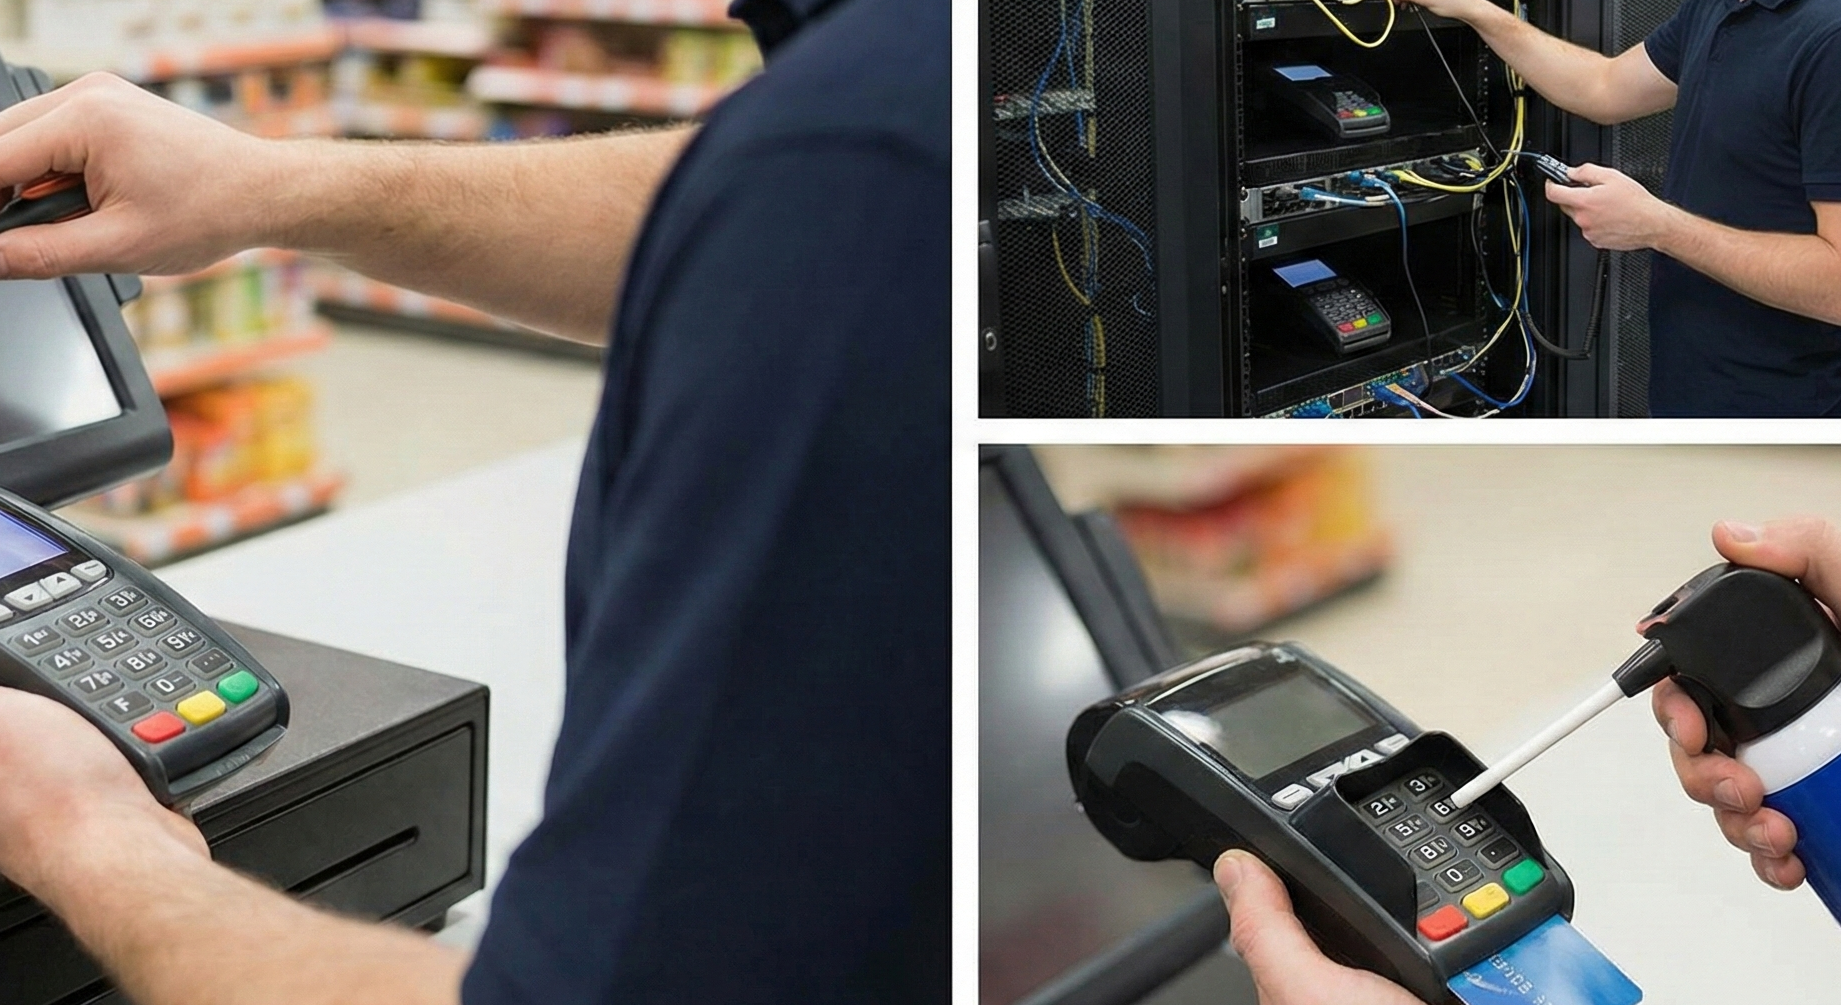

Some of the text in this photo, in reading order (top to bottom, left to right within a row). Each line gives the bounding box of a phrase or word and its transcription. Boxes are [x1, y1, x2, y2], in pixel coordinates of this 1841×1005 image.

[23, 634, 40, 645] 1
[69, 615, 88, 627] 2
[110, 595, 128, 606] 3
[55, 655, 71, 668] 4
[97, 635, 116, 648] 5
[138, 615, 156, 628] 6
[80, 676, 97, 689] 7
[127, 657, 146, 669] 8
[167, 637, 185, 649] 9
[113, 679, 175, 712] F 0
[1370, 802, 1388, 815] 2
[1409, 779, 1426, 792] 3
[1395, 824, 1412, 837] 5
[1434, 801, 1450, 815] 6
[1420, 846, 1436, 860] 8
[1459, 824, 1475, 837] 9
[1446, 867, 1462, 883] 0
